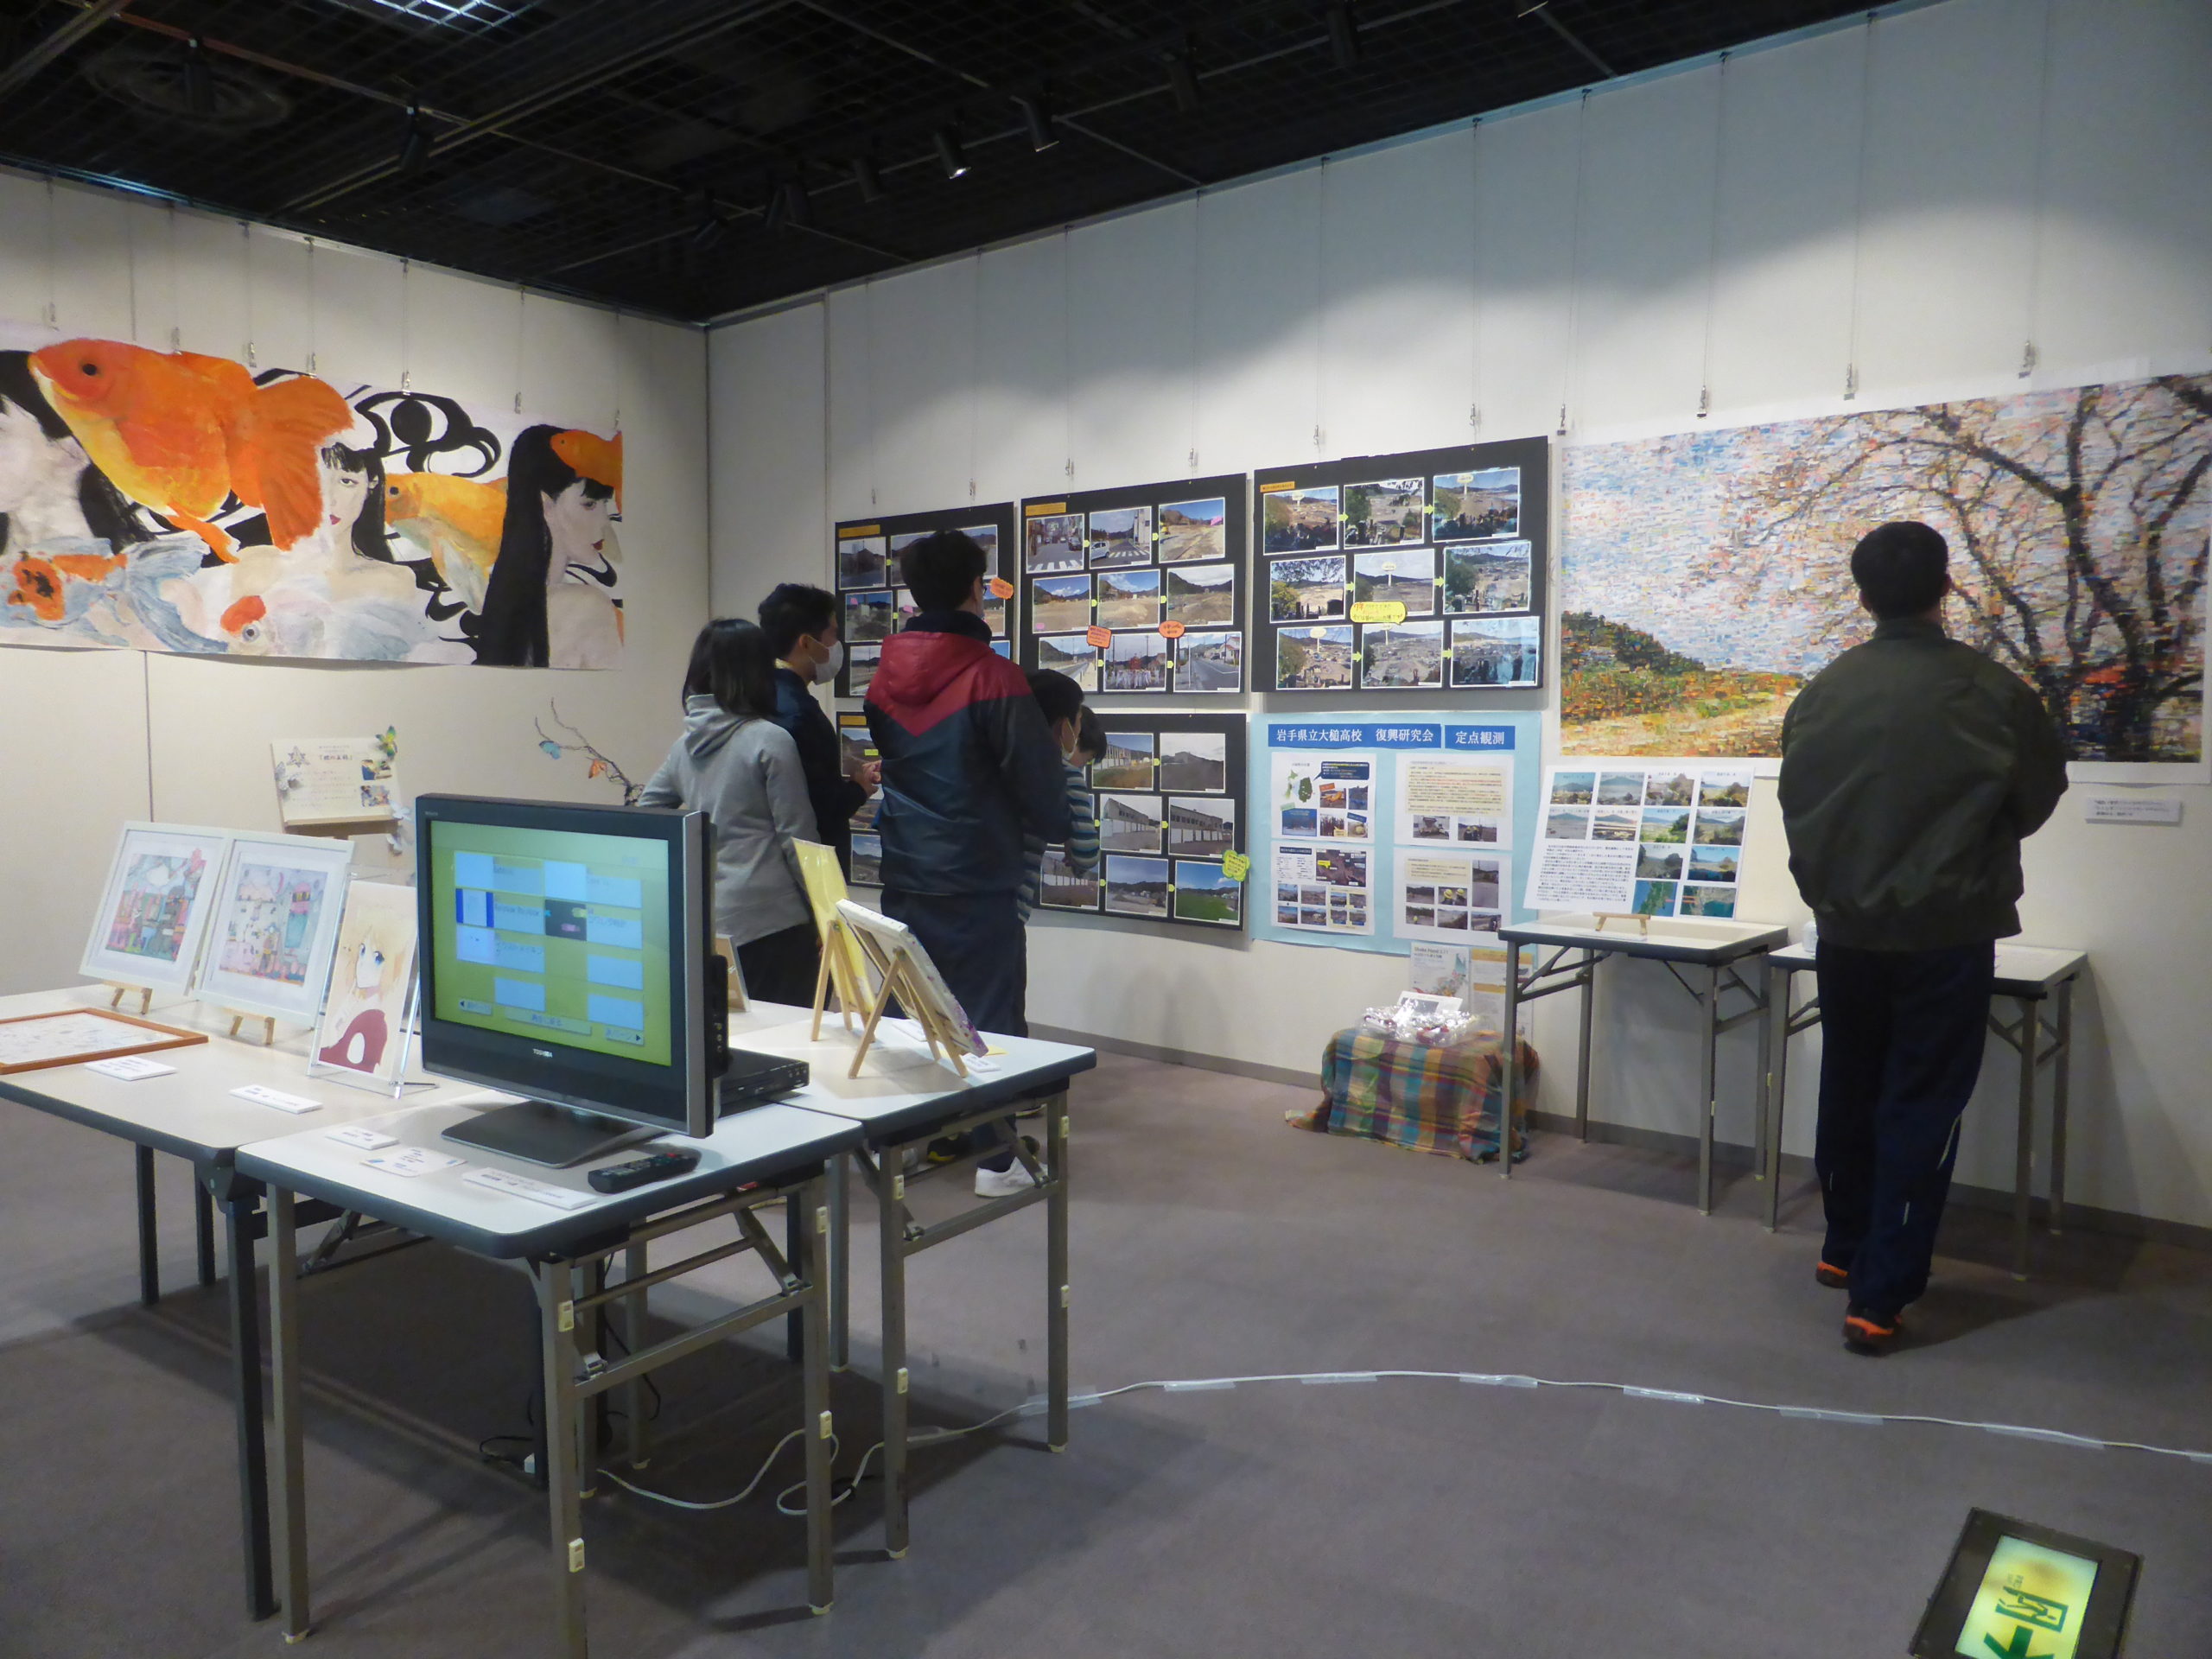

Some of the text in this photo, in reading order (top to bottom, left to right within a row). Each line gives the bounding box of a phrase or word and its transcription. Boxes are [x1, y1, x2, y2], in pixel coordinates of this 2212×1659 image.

[1276, 728, 1504, 745] 岩手県立大槌高校 復興研究会 定点観測
